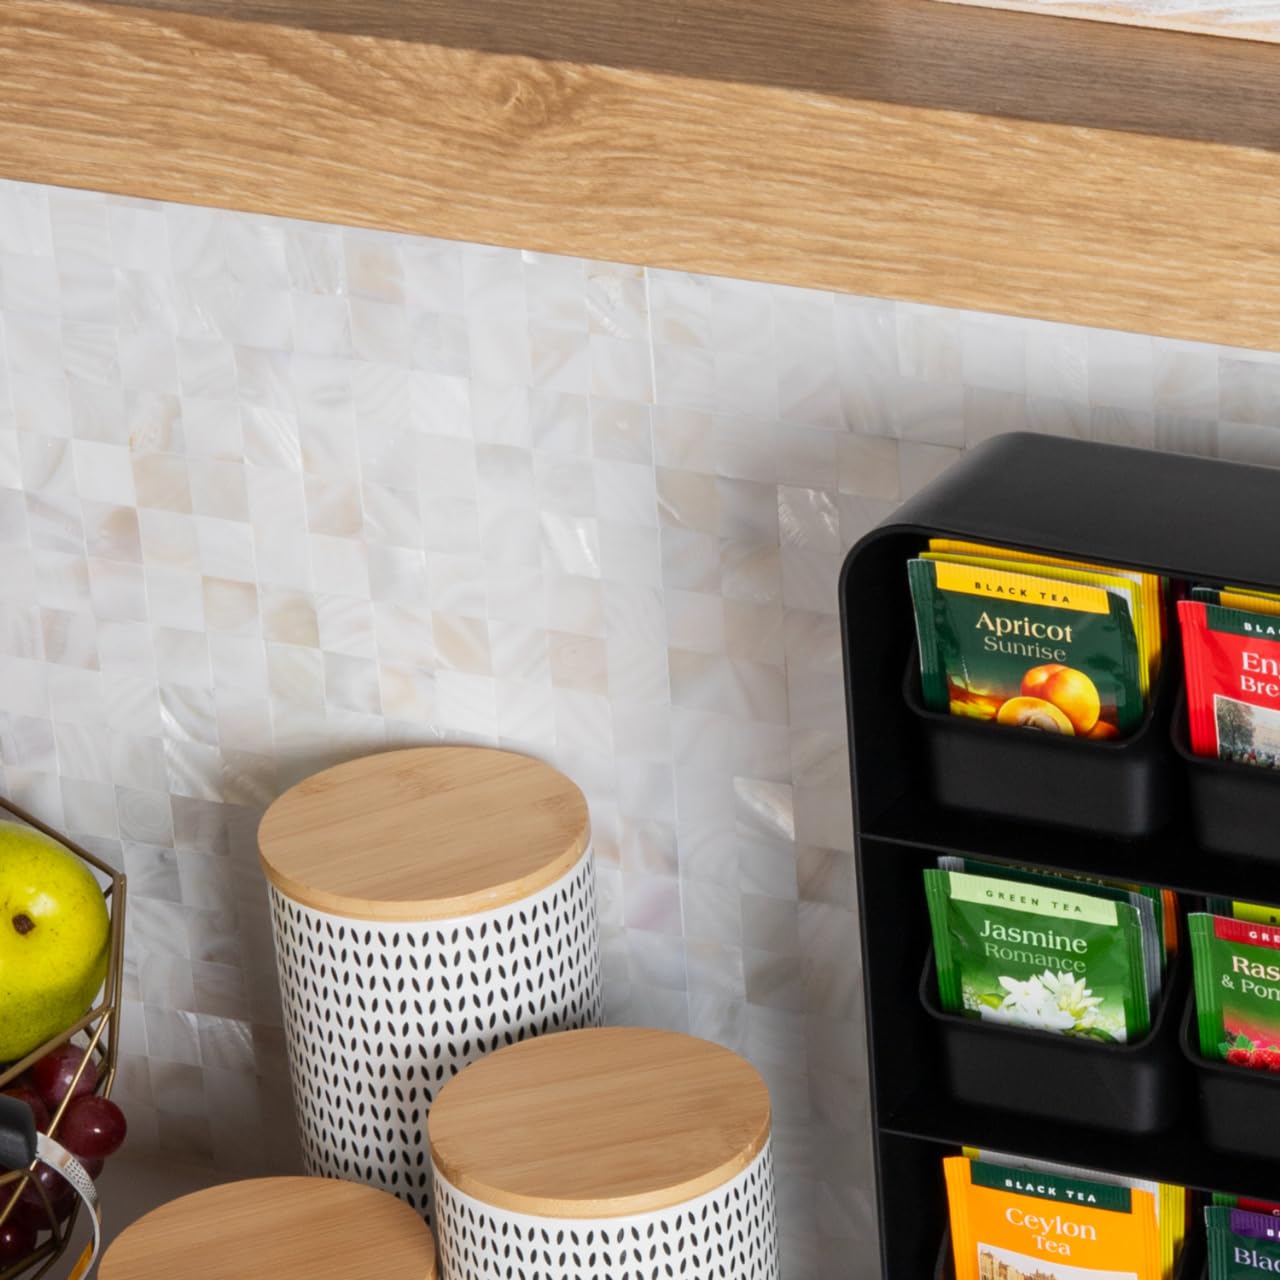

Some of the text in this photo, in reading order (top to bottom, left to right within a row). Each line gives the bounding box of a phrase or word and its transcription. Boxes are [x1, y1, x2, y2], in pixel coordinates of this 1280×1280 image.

[975, 582, 1070, 603] BLACK TEA
[975, 611, 1073, 643] Apricot
[984, 636, 1067, 661] Sunrise
[986, 890, 1082, 913] GREEN TEA
[980, 920, 1088, 954] Jasmine
[984, 943, 1087, 973] Romance
[1221, 974, 1235, 990] &
[1005, 1179, 1097, 1203] BLACK TEA
[1006, 1207, 1097, 1241] Ceylon
[1032, 1233, 1071, 1256] Tea
